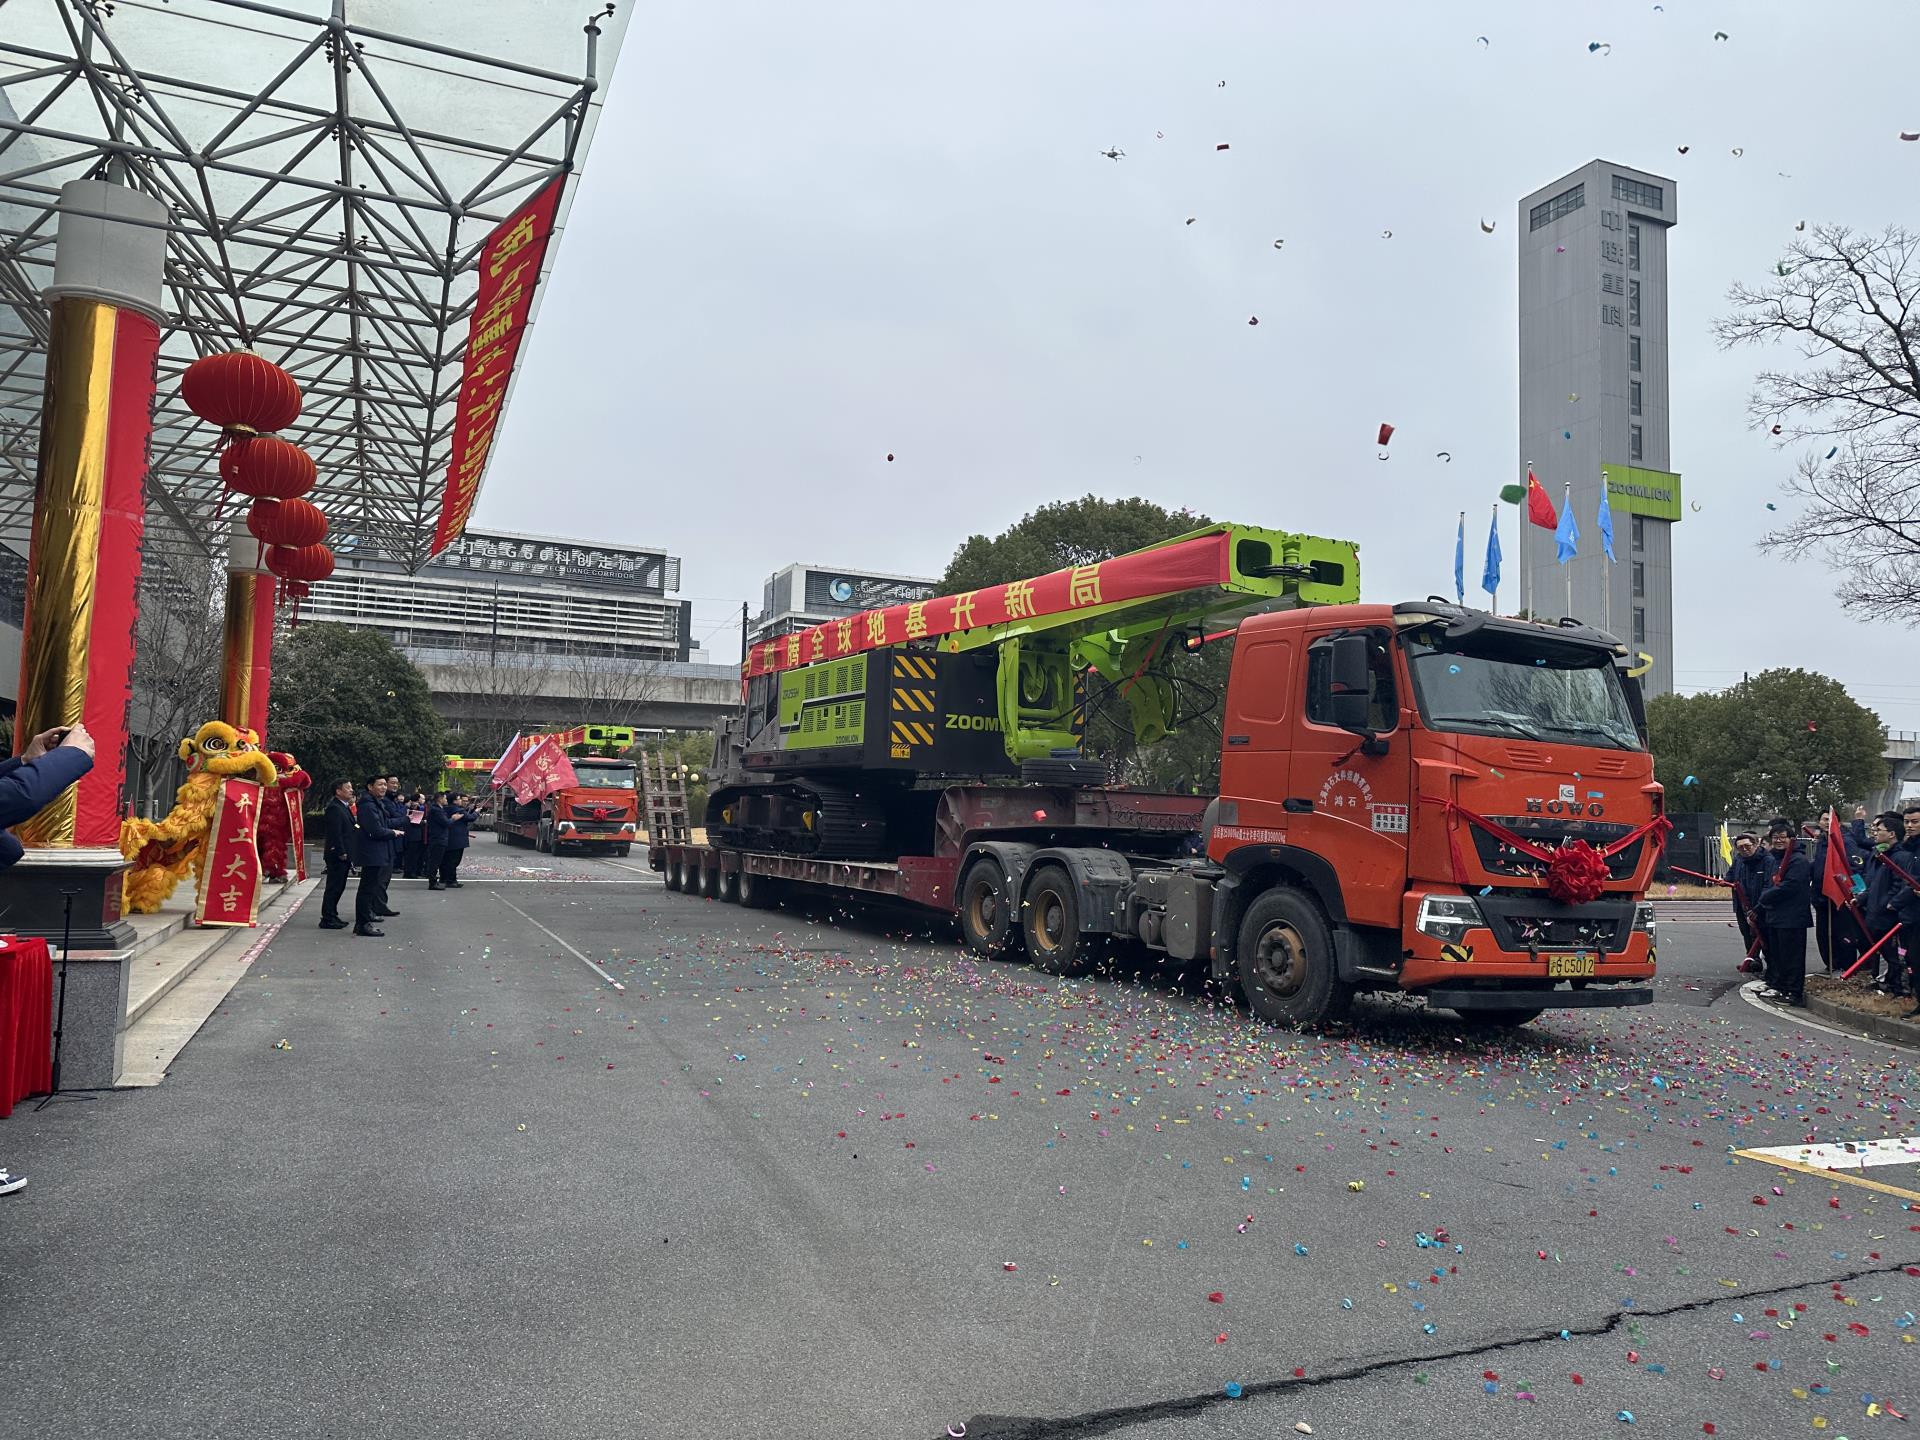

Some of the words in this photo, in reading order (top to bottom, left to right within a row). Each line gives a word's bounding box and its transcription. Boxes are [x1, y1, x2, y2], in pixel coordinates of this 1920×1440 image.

[1601, 210, 1624, 327] 中联重科
[1607, 481, 1672, 503] ZOOMLION
[945, 713, 1004, 732] ZOOM
[1334, 795, 1357, 808] 鸿石
[1525, 797, 1604, 817] HOWO
[219, 792, 253, 912] 开工大吉
